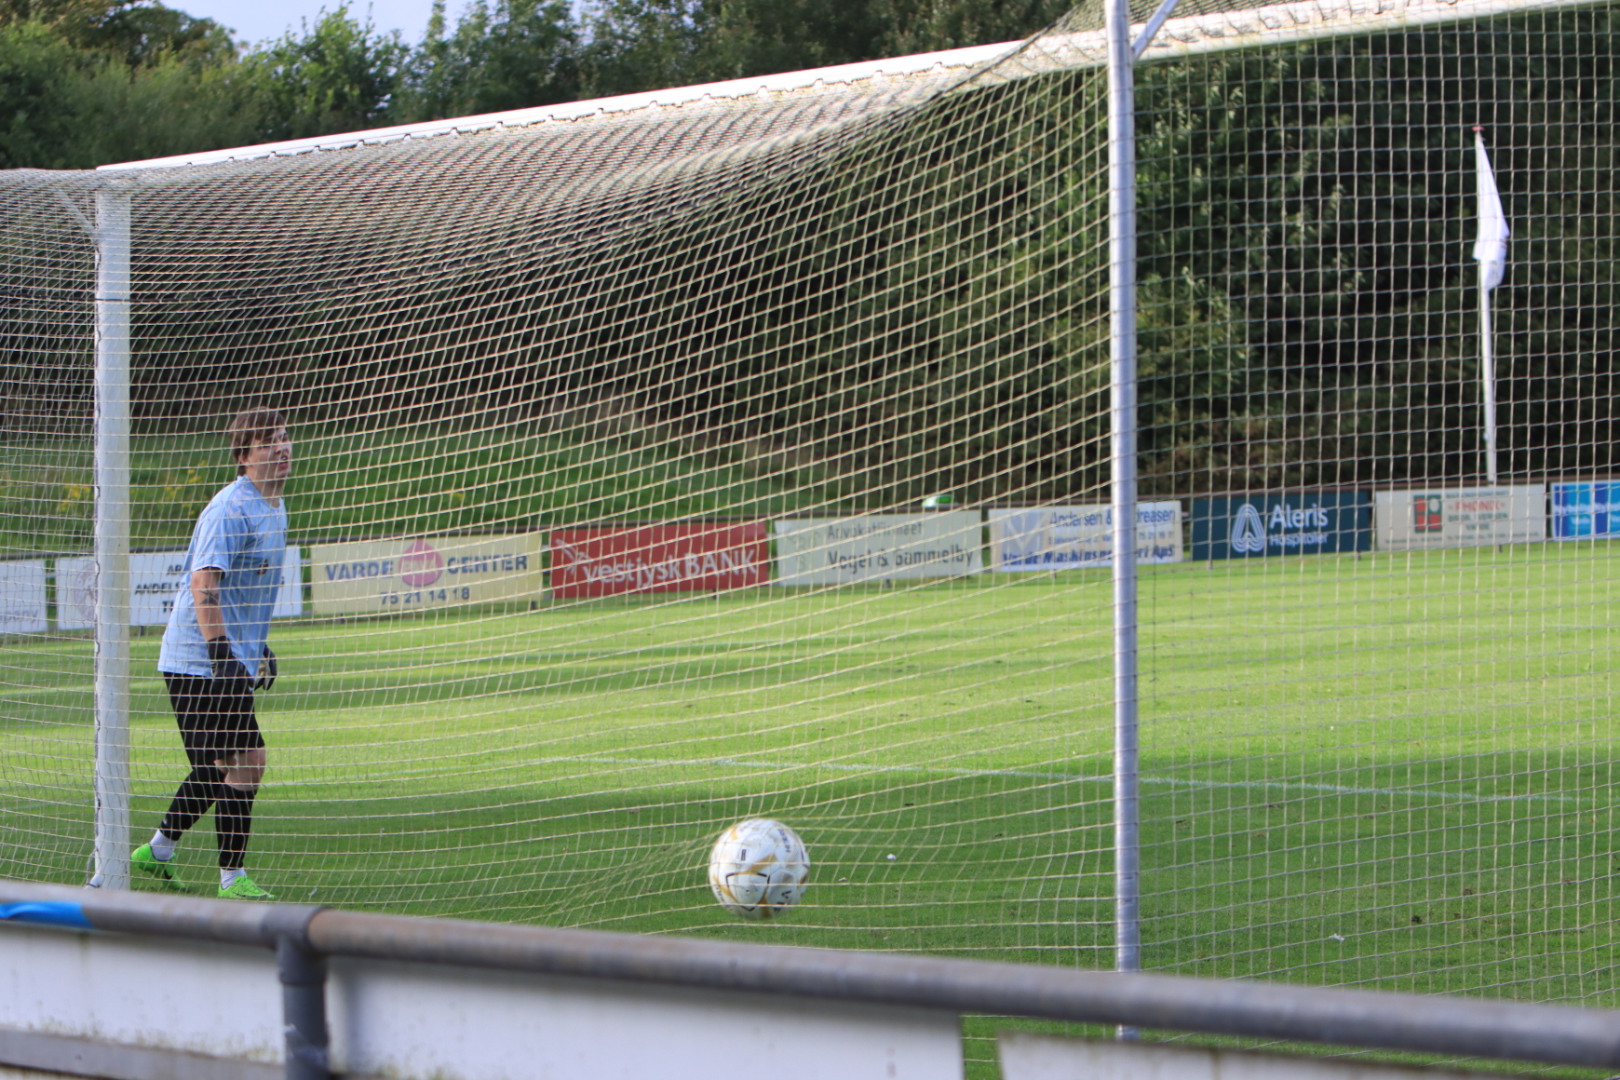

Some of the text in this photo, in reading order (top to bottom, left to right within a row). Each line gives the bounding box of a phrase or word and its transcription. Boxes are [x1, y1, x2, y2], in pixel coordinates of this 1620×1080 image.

[1269, 503, 1328, 529] Aleris
[325, 560, 394, 581] VARDE
[447, 554, 528, 574] CENTER
[828, 550, 872, 574] Vogel
[877, 548, 889, 567] &
[380, 586, 470, 606] 75 21 14 18
